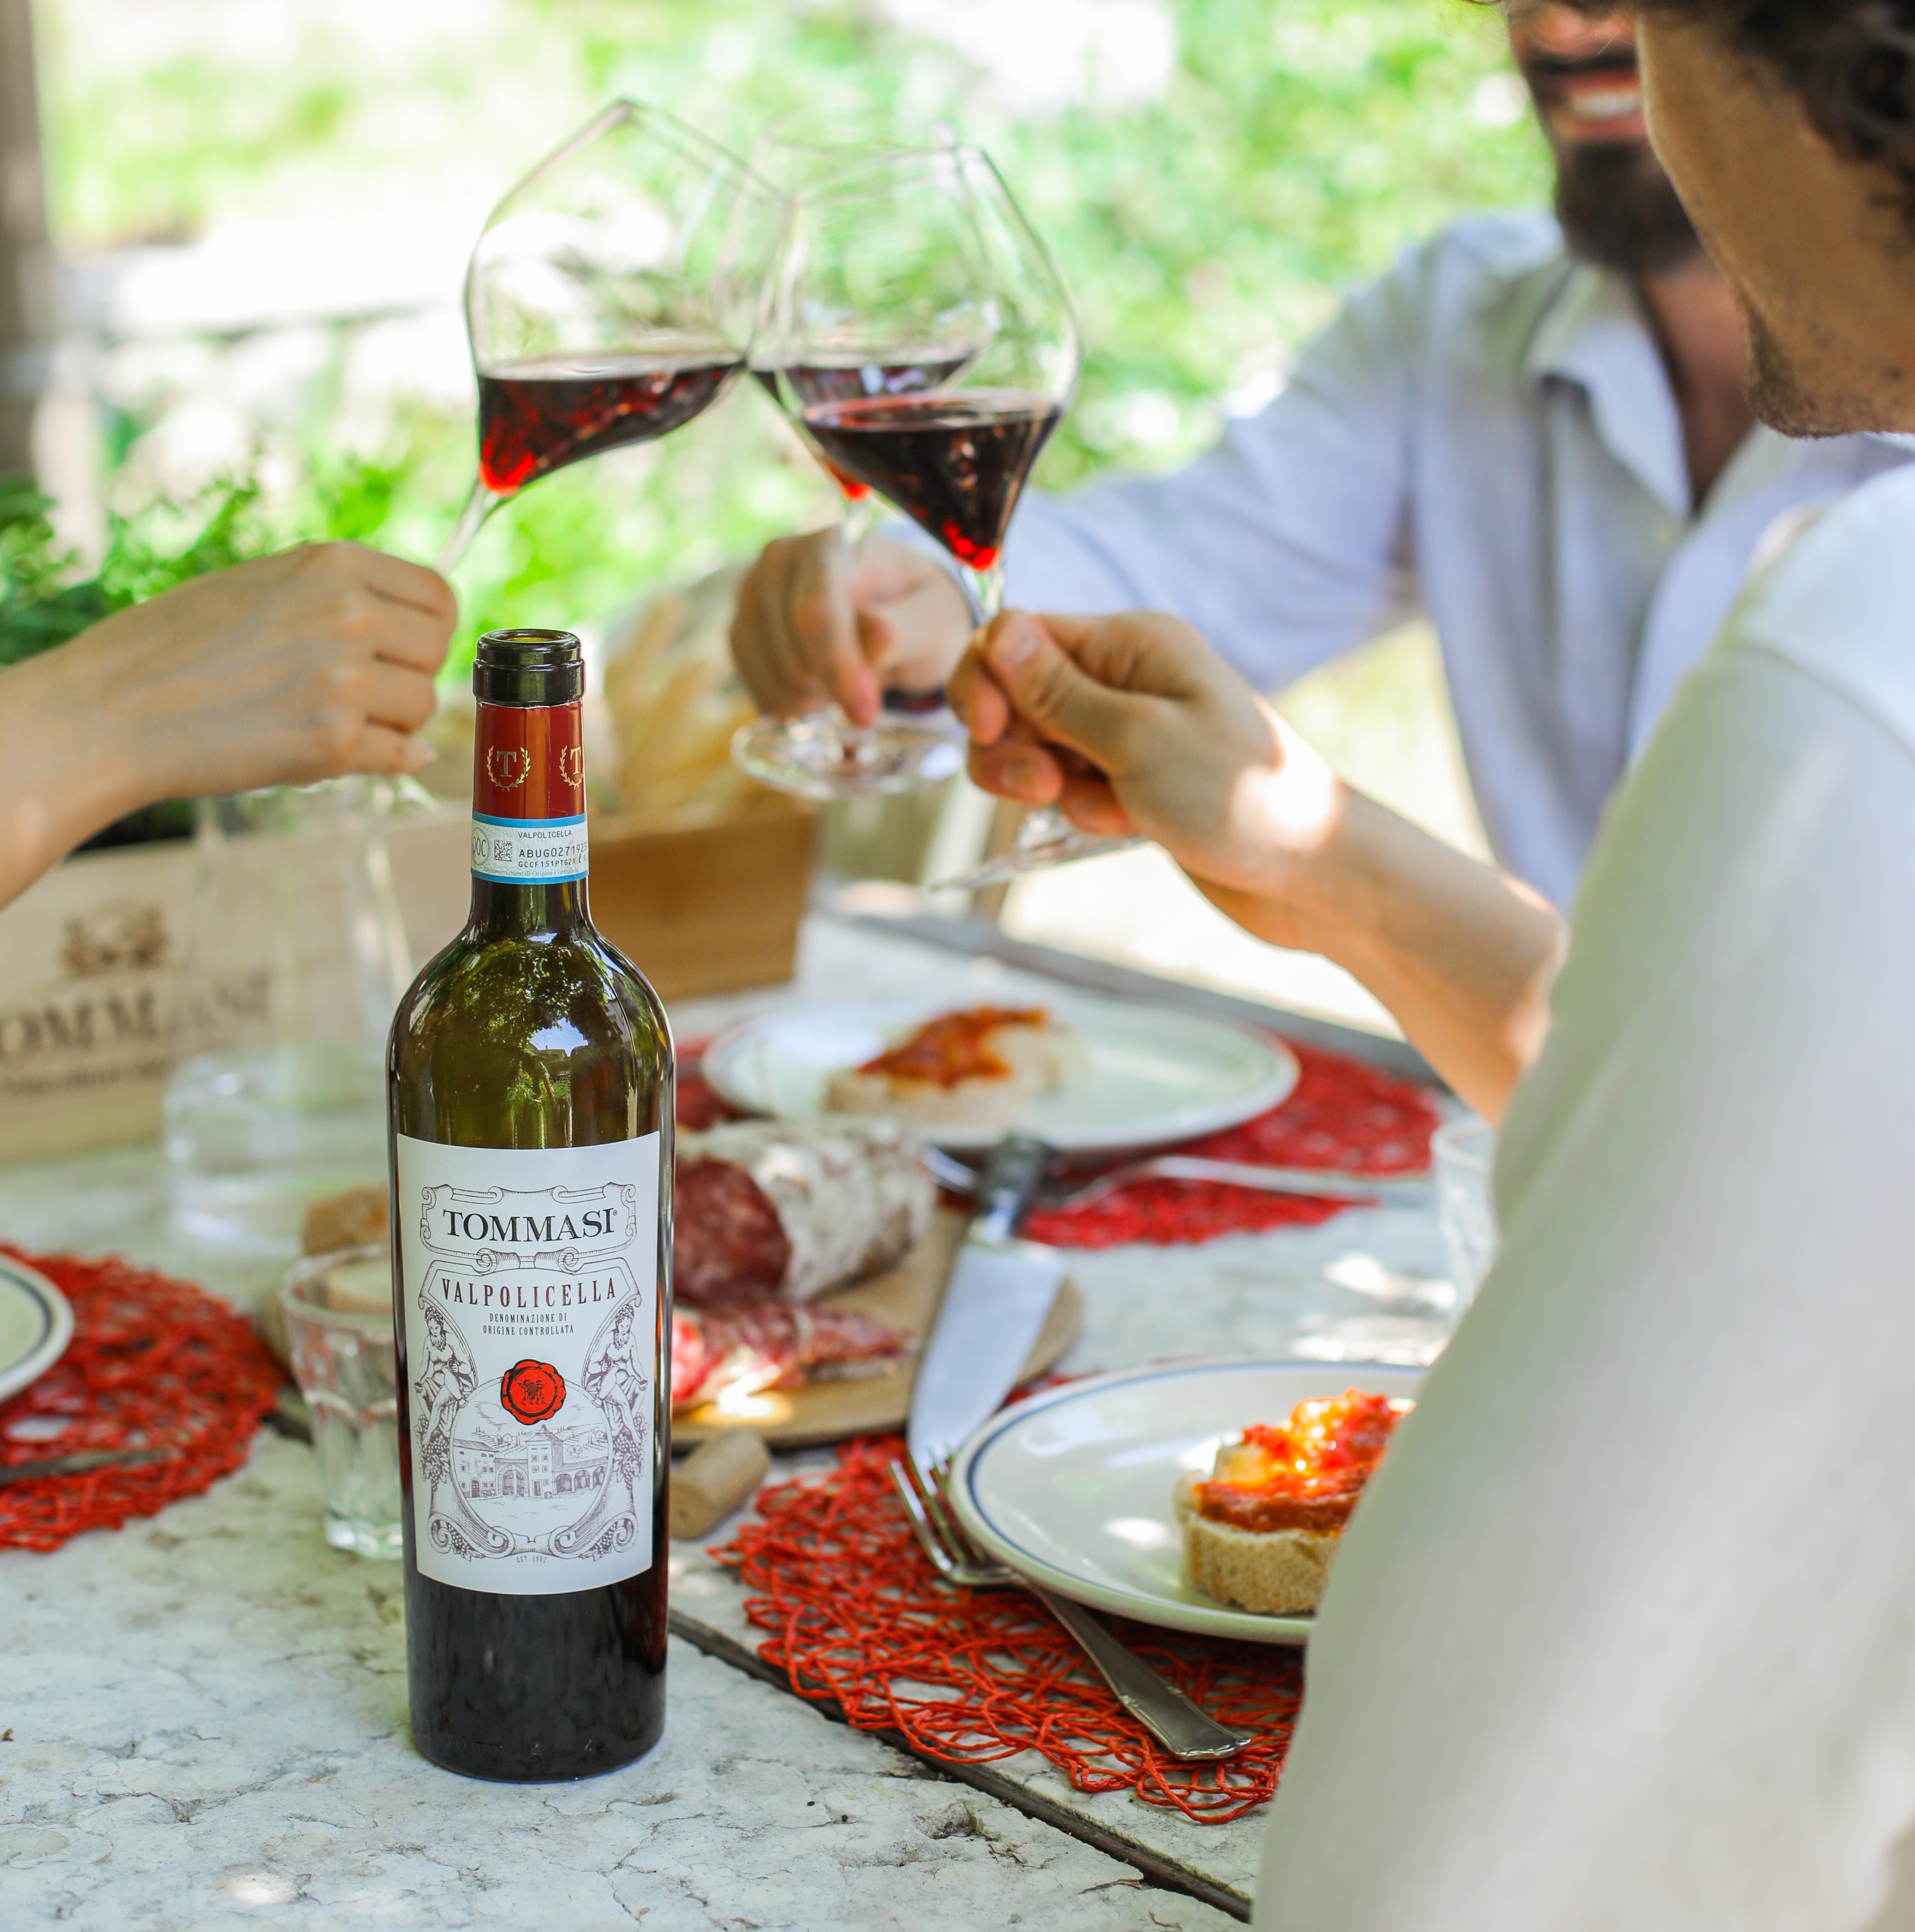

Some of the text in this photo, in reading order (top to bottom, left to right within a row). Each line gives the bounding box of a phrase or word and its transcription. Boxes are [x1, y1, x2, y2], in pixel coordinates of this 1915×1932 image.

[497, 751, 516, 777] T
[570, 746, 581, 775] T
[518, 830, 572, 838] VALPOLICELLA
[473, 836, 486, 857] DOC
[443, 1208, 614, 1242] TOMMASI
[441, 1277, 616, 1308] VALPOLICELLA
[489, 1313, 567, 1323] DENOMINAZIONE DI
[483, 1324, 574, 1336] ORIGINE CONTROLLATA
